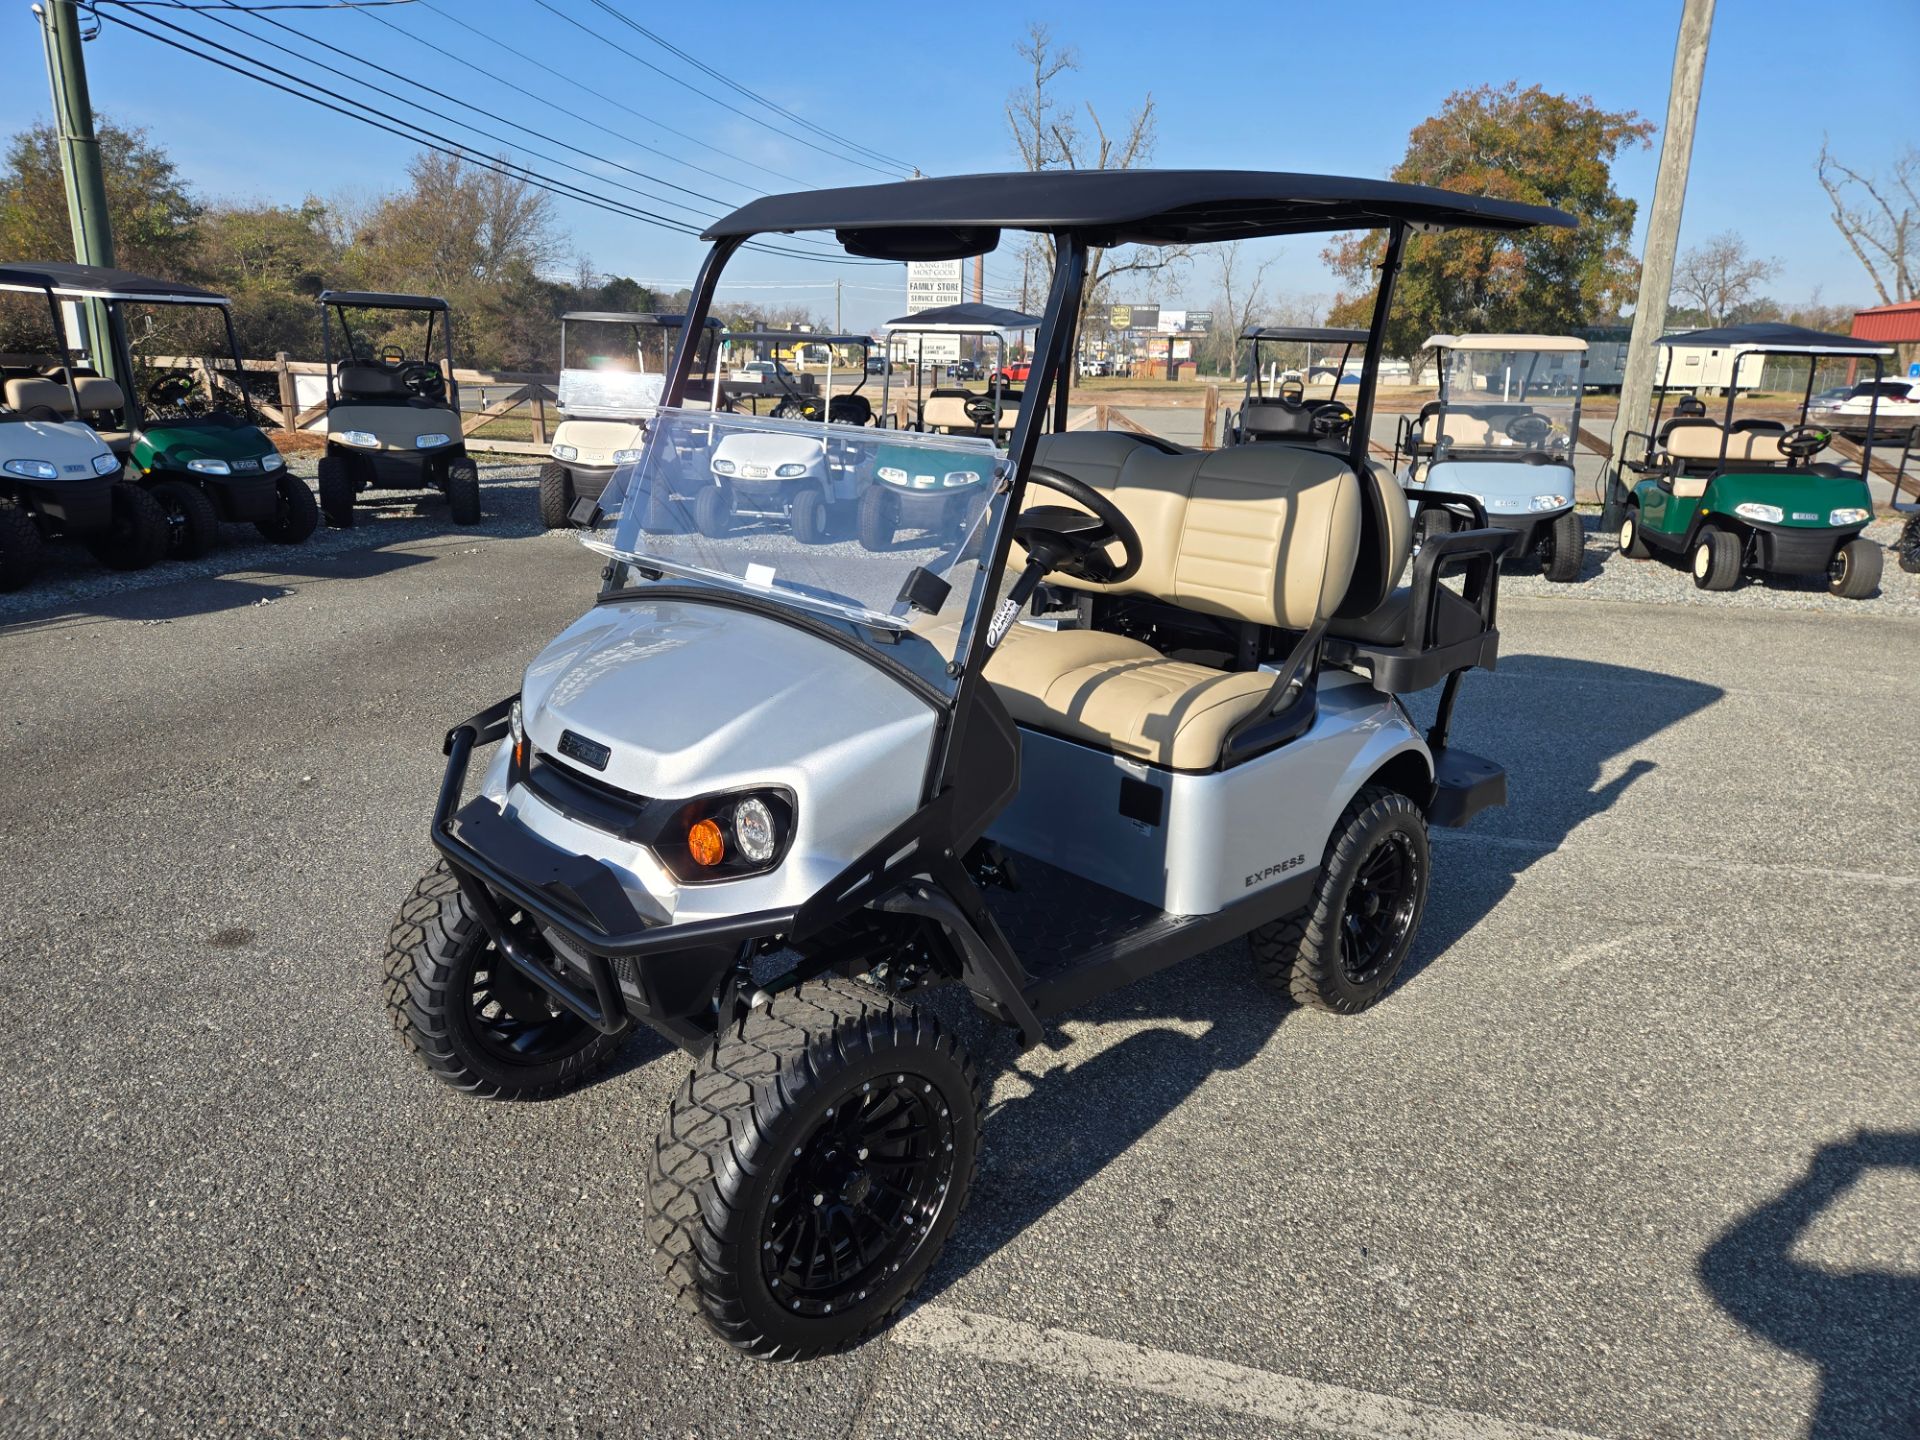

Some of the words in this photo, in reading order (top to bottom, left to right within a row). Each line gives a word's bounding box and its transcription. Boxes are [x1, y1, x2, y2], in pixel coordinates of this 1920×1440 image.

[909, 282, 934, 291] FAMILY
[937, 282, 959, 291] STORE
[936, 295, 958, 303] CENTER
[1245, 854, 1306, 888] EXPRESS
